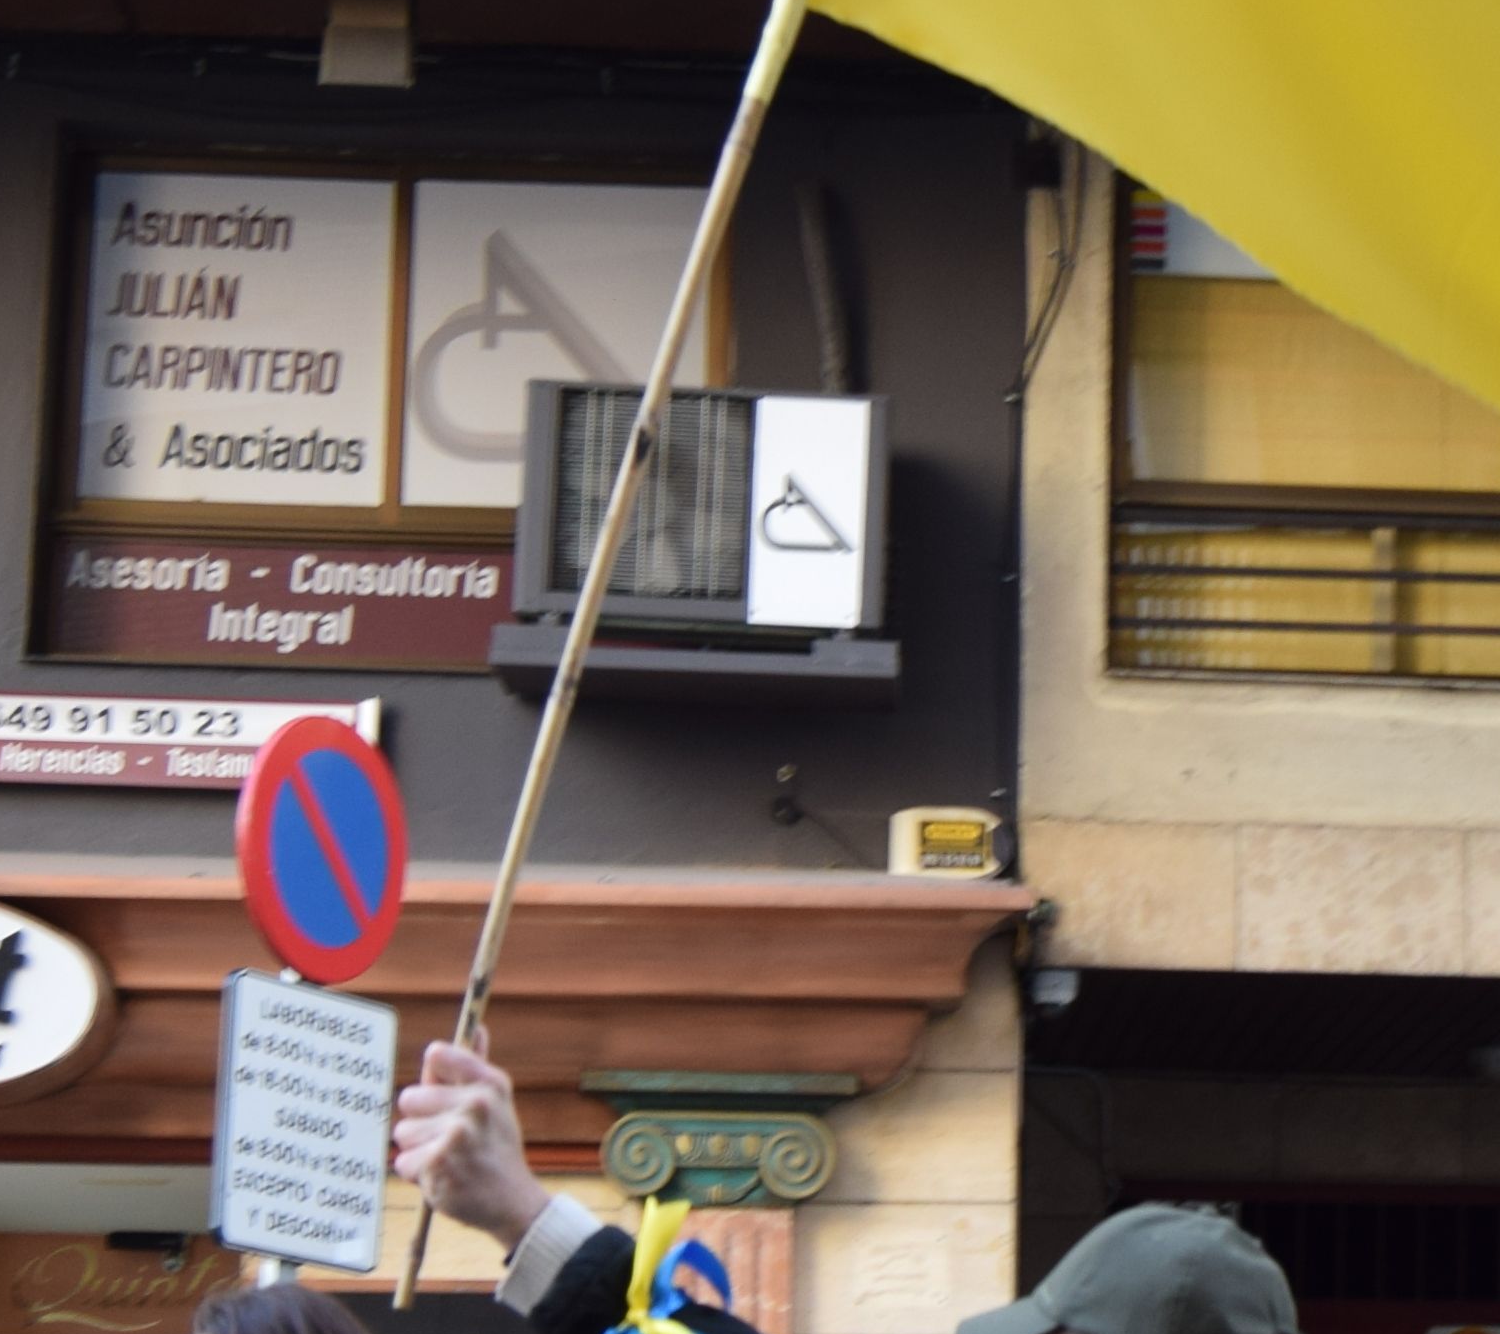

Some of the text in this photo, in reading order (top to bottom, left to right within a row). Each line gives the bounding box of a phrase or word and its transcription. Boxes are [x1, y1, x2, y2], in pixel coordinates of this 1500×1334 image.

[111, 201, 292, 254] Asunción
[107, 265, 239, 322] JULIÁN
[104, 343, 342, 397] CARPINTERO
[104, 421, 366, 475] & Asociados
[206, 601, 356, 655] Integral
[68, 705, 113, 734] 91
[129, 707, 179, 737] 50
[193, 709, 242, 738] 23
[165, 746, 257, 780] Testam
[11, 1243, 237, 1332] Quint
